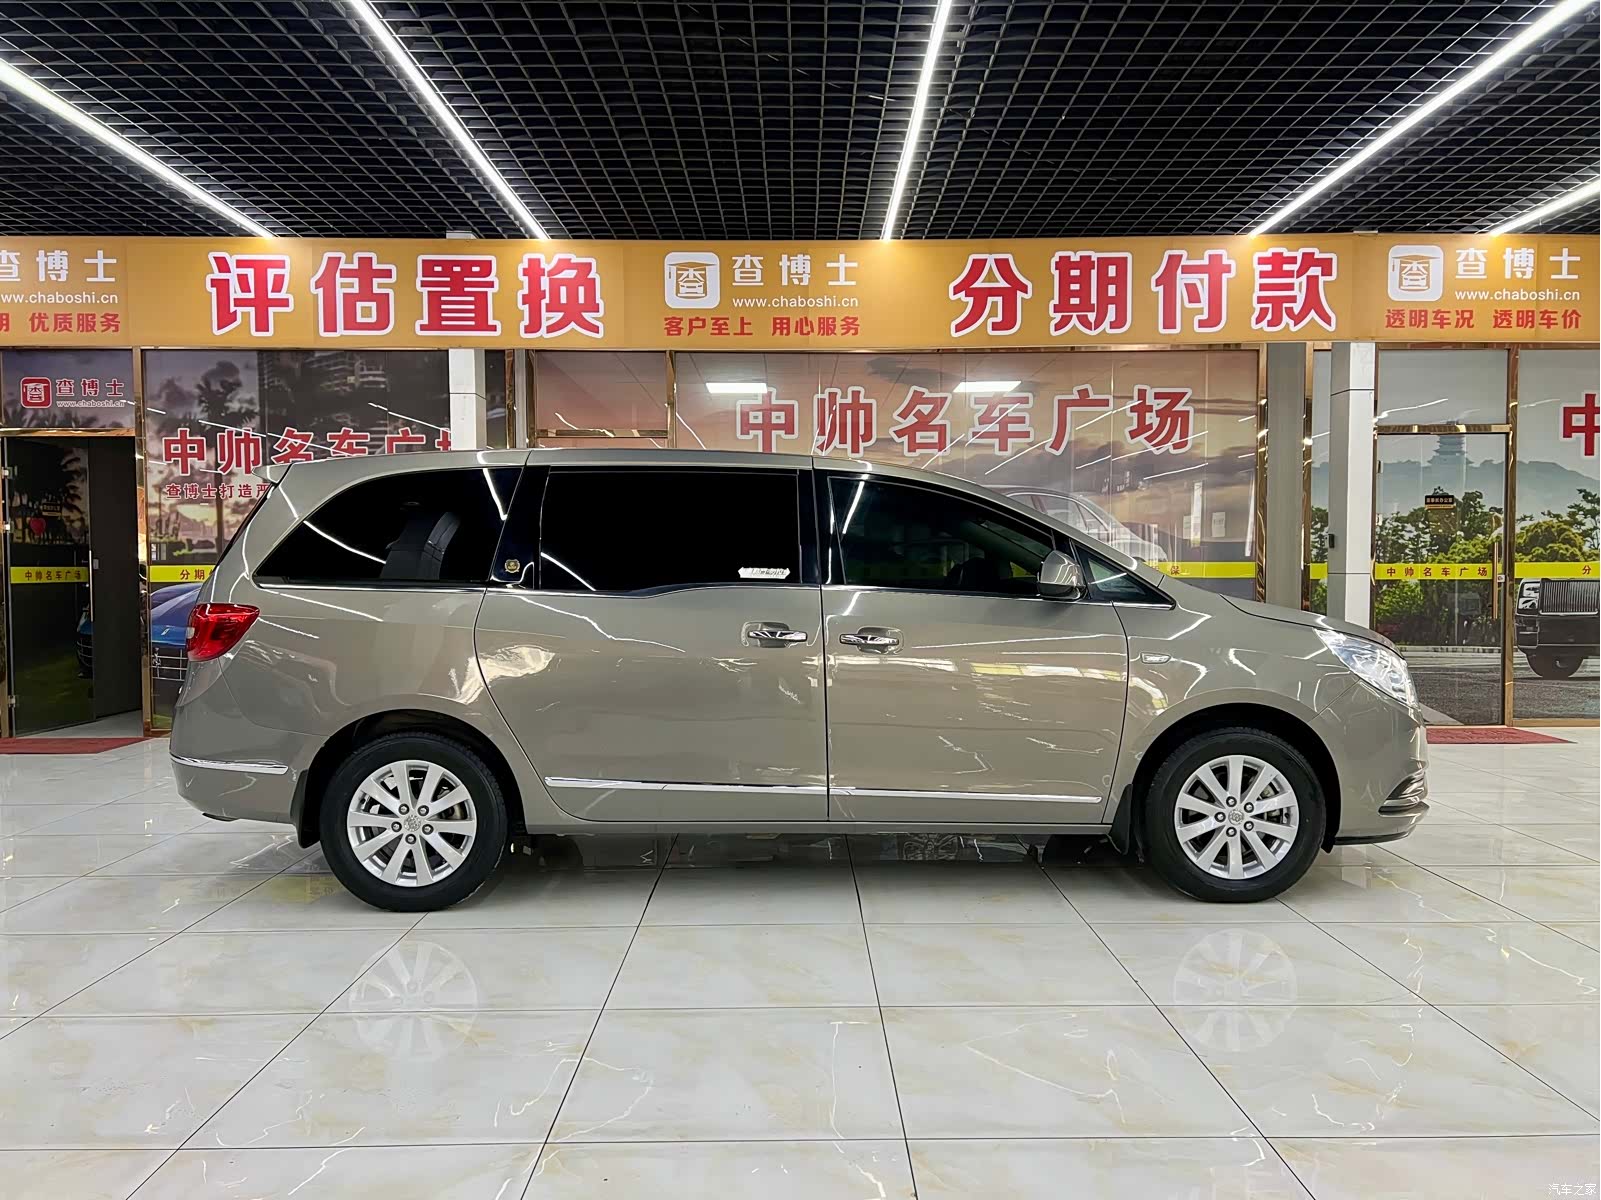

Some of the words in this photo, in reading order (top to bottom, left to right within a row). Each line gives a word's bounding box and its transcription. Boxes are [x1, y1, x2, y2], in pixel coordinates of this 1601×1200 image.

[0, 249, 118, 282] 查博士
[731, 253, 859, 286] 查博士
[1455, 247, 1581, 280] 查博士
[207, 252, 603, 338] 评估置换
[732, 295, 859, 308] www.chaboshi.cn
[950, 248, 1337, 337] 分期付款
[1454, 287, 1581, 301] www.chaboshi.cn
[28, 312, 121, 333] 优质服务
[663, 316, 753, 337] 客户至上
[771, 315, 861, 337] 用心服务
[1385, 308, 1475, 329] 透明车况
[1492, 308, 1582, 329] 透明车价
[56, 379, 124, 396] 查博士
[56, 399, 125, 408] www.chaboshi.cn
[736, 385, 1194, 457] 中帅名车广场
[1561, 392, 1600, 457] 中
[24, 569, 81, 581] 中帅名车广场
[180, 569, 213, 580] 分期
[1386, 566, 1489, 577] 中帅名车广场
[1582, 564, 1592, 575] 分
